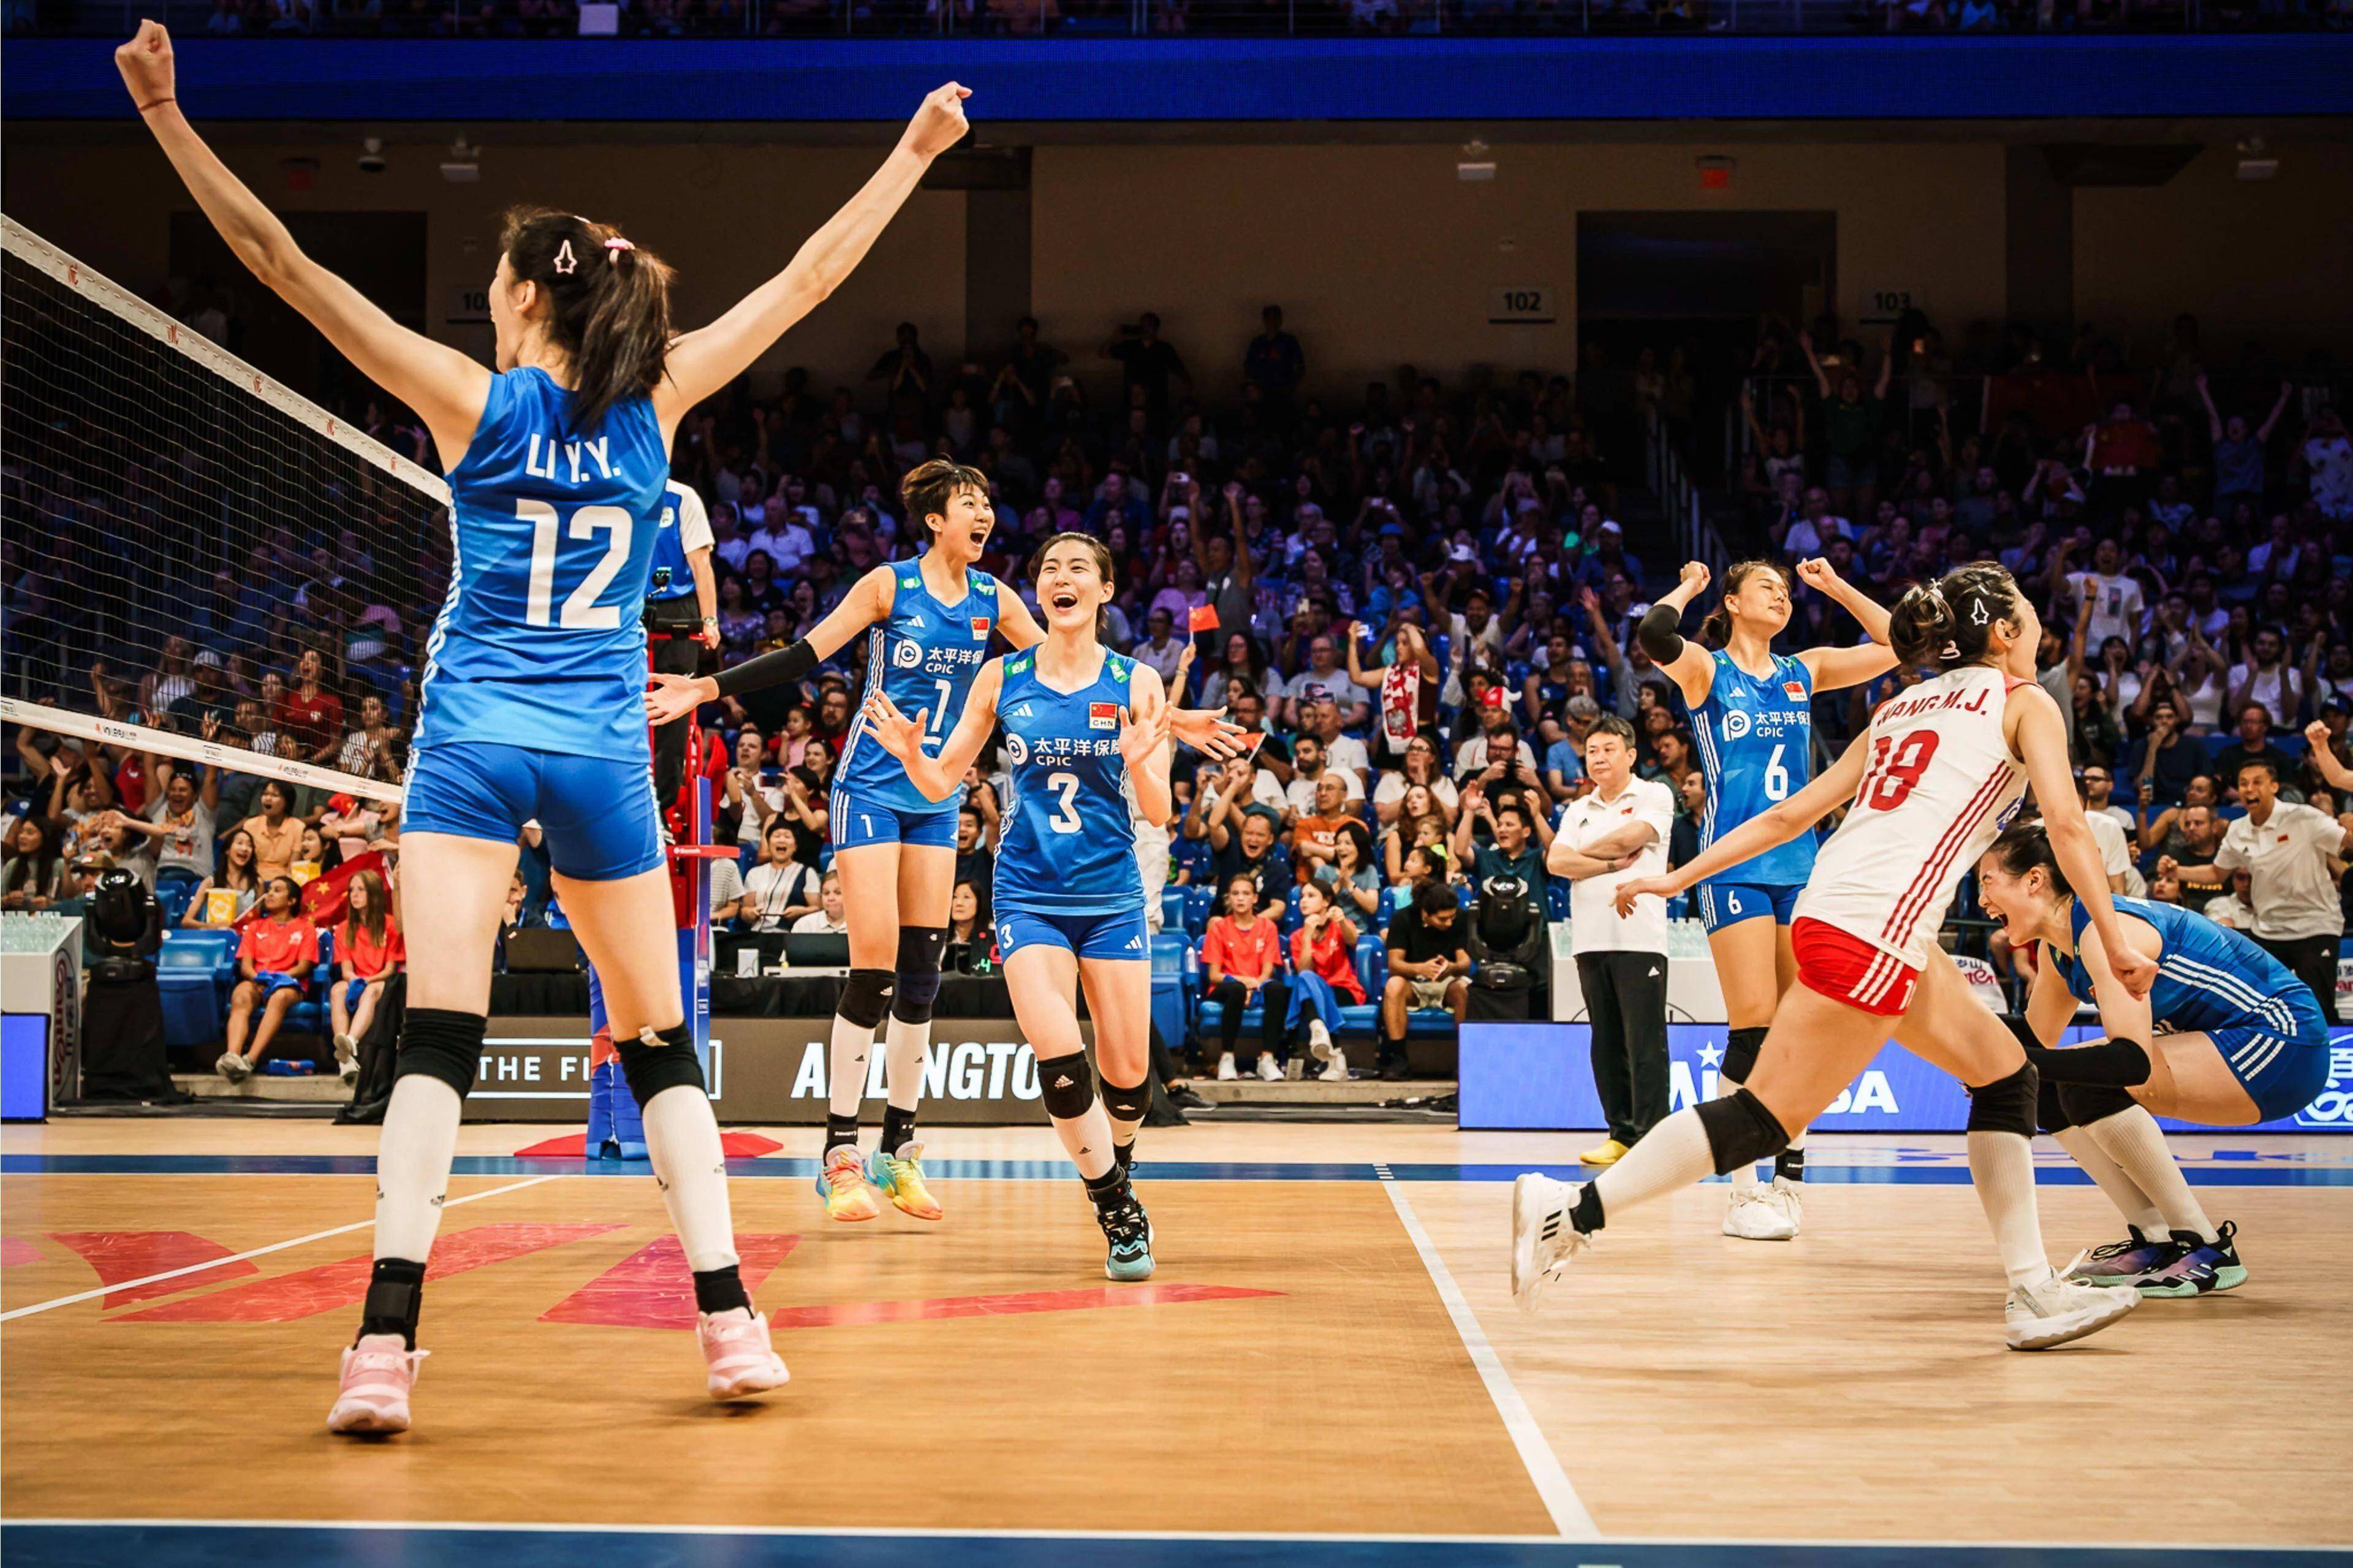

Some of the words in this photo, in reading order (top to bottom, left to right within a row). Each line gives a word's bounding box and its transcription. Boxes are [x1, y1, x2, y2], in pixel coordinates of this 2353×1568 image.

[463, 292, 490, 311] 10
[1503, 292, 1541, 311] 102
[515, 498, 632, 629] 12
[925, 662, 954, 674] CPIC
[931, 678, 952, 732] 1
[1754, 711, 1811, 726] 太平洋保
[1756, 727, 1784, 737] CPIC
[1036, 756, 1072, 767] CPIC
[1764, 744, 1789, 801] 6
[1854, 730, 1939, 811] 18
[1047, 772, 1082, 833] 3
[860, 814, 873, 838] 1
[1727, 890, 1743, 915] 6
[1001, 923, 1014, 950] 3
[1898, 979, 1917, 1010] 1
[479, 1056, 541, 1081] THE
[790, 1042, 1086, 1100] ALNGTO
